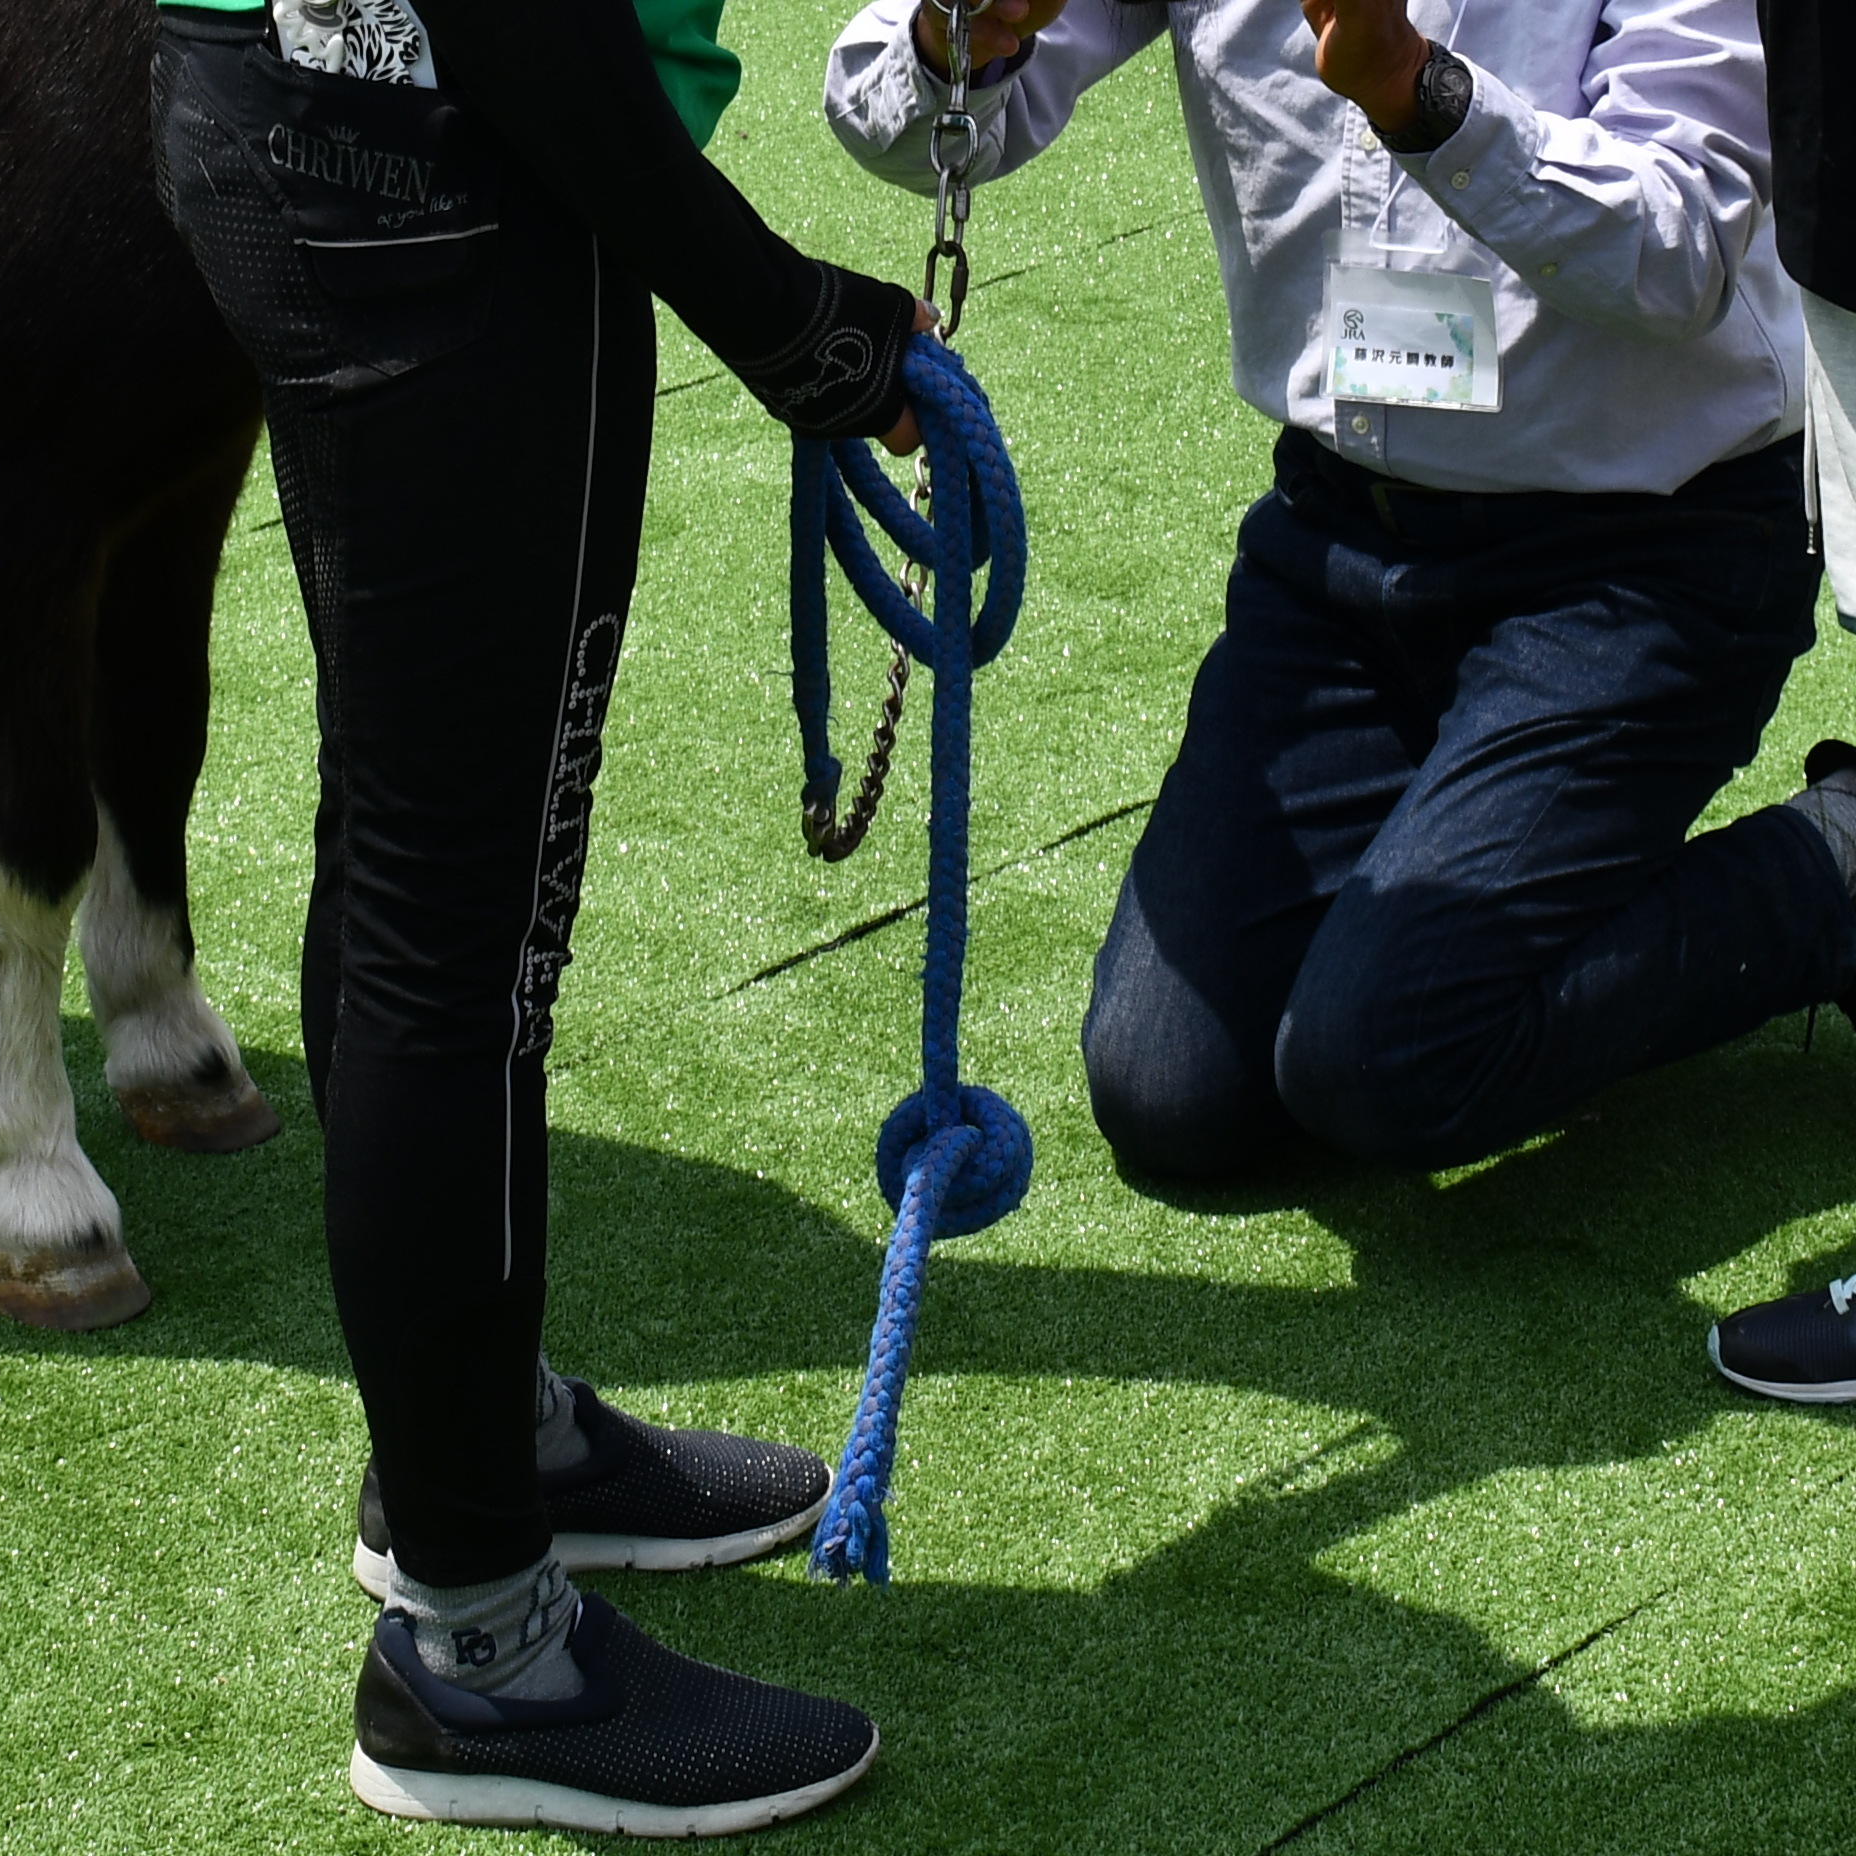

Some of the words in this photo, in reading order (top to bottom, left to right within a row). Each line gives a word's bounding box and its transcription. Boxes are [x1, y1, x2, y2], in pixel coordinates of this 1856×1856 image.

[267, 122, 436, 204] CHRIWEN
[429, 193, 454, 215] like
[1340, 328, 1366, 341] JRA
[1353, 347, 1456, 370] 藤沢元調教師
